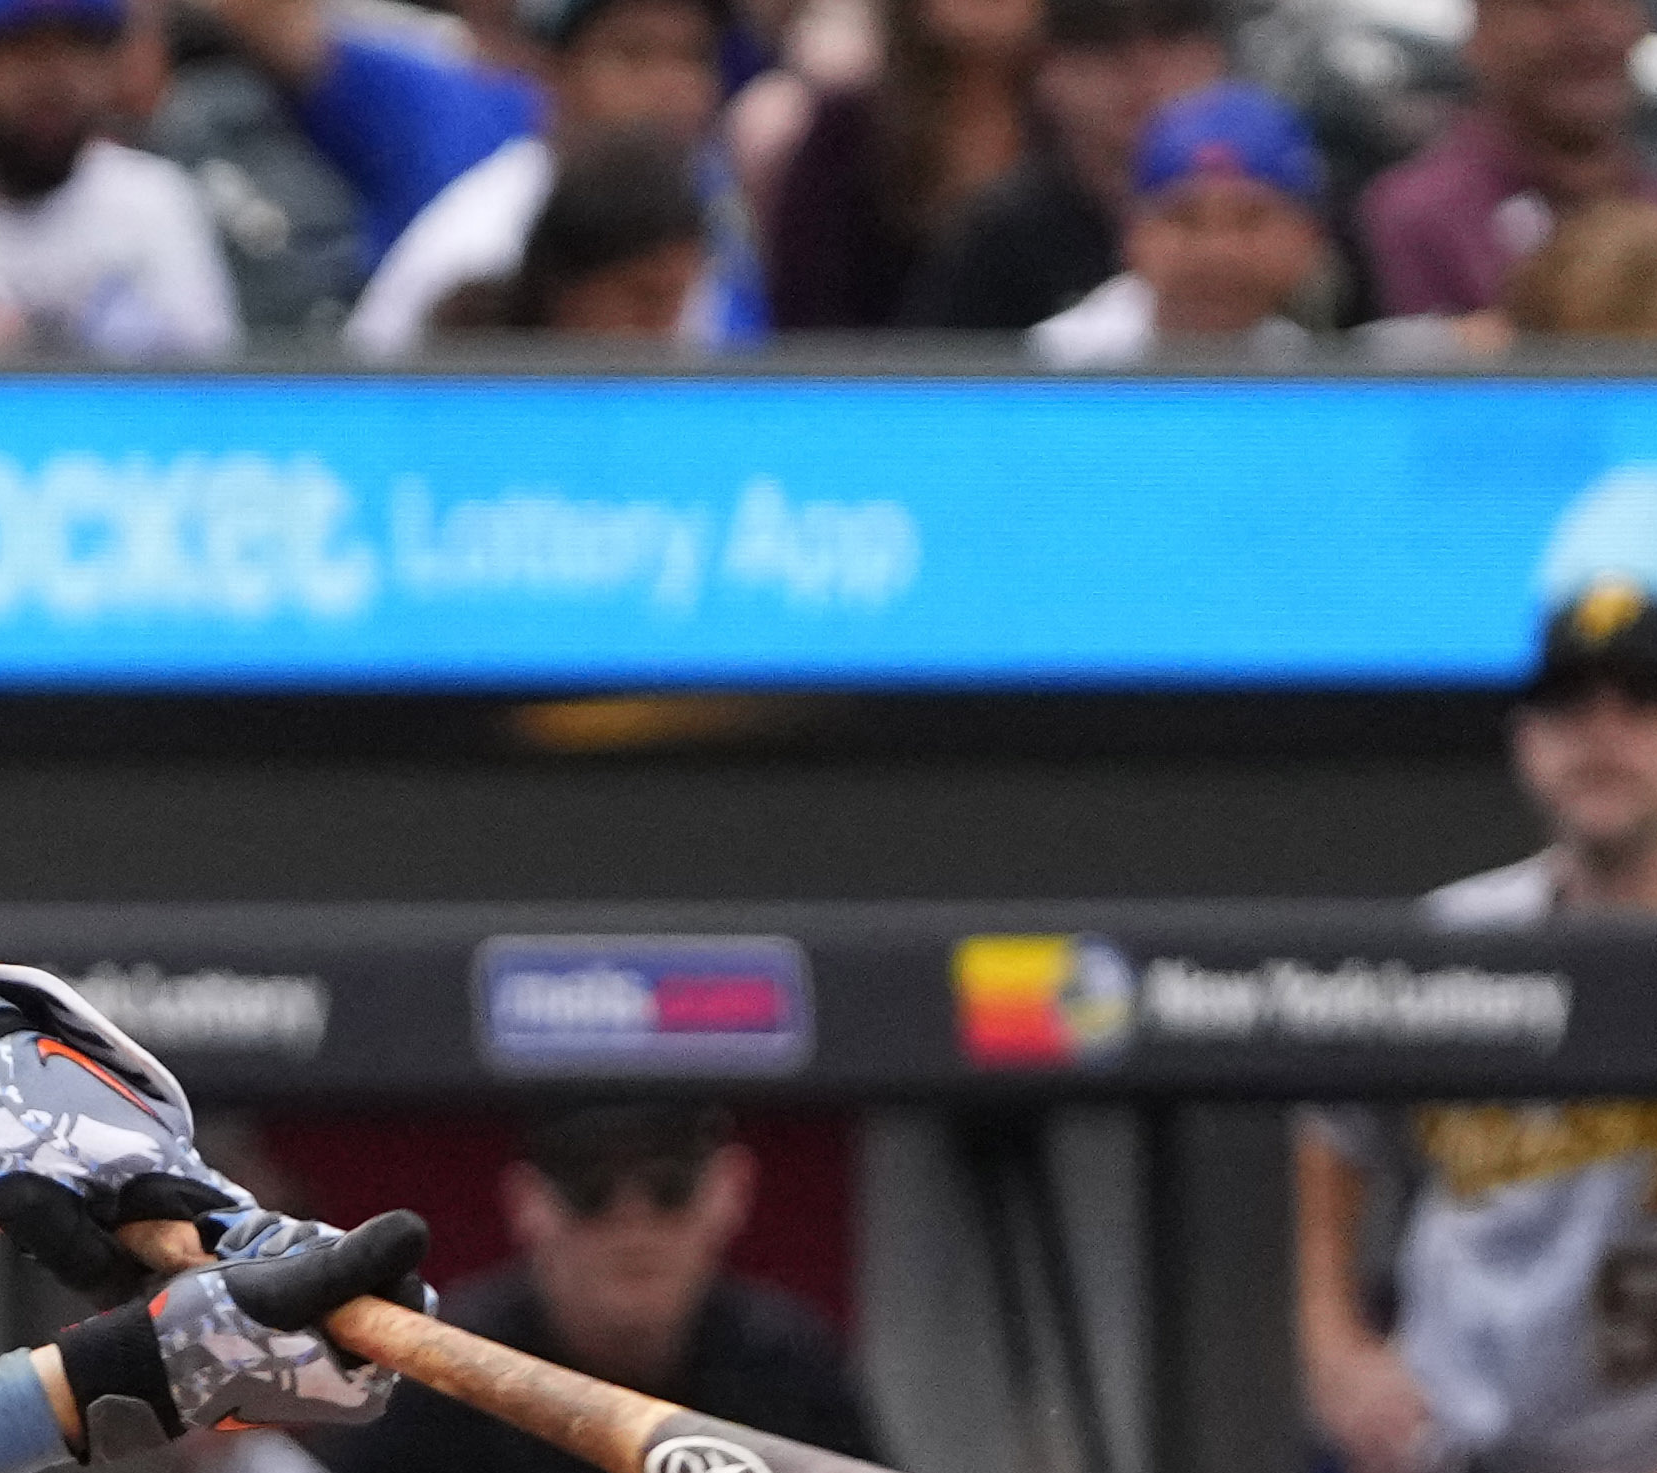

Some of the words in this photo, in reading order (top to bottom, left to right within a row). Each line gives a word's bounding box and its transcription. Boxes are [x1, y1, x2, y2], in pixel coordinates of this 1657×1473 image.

[391, 475, 705, 622] Lottery
[725, 475, 921, 616] App
[1145, 957, 1259, 1040] New
[1263, 957, 1383, 1042] York
